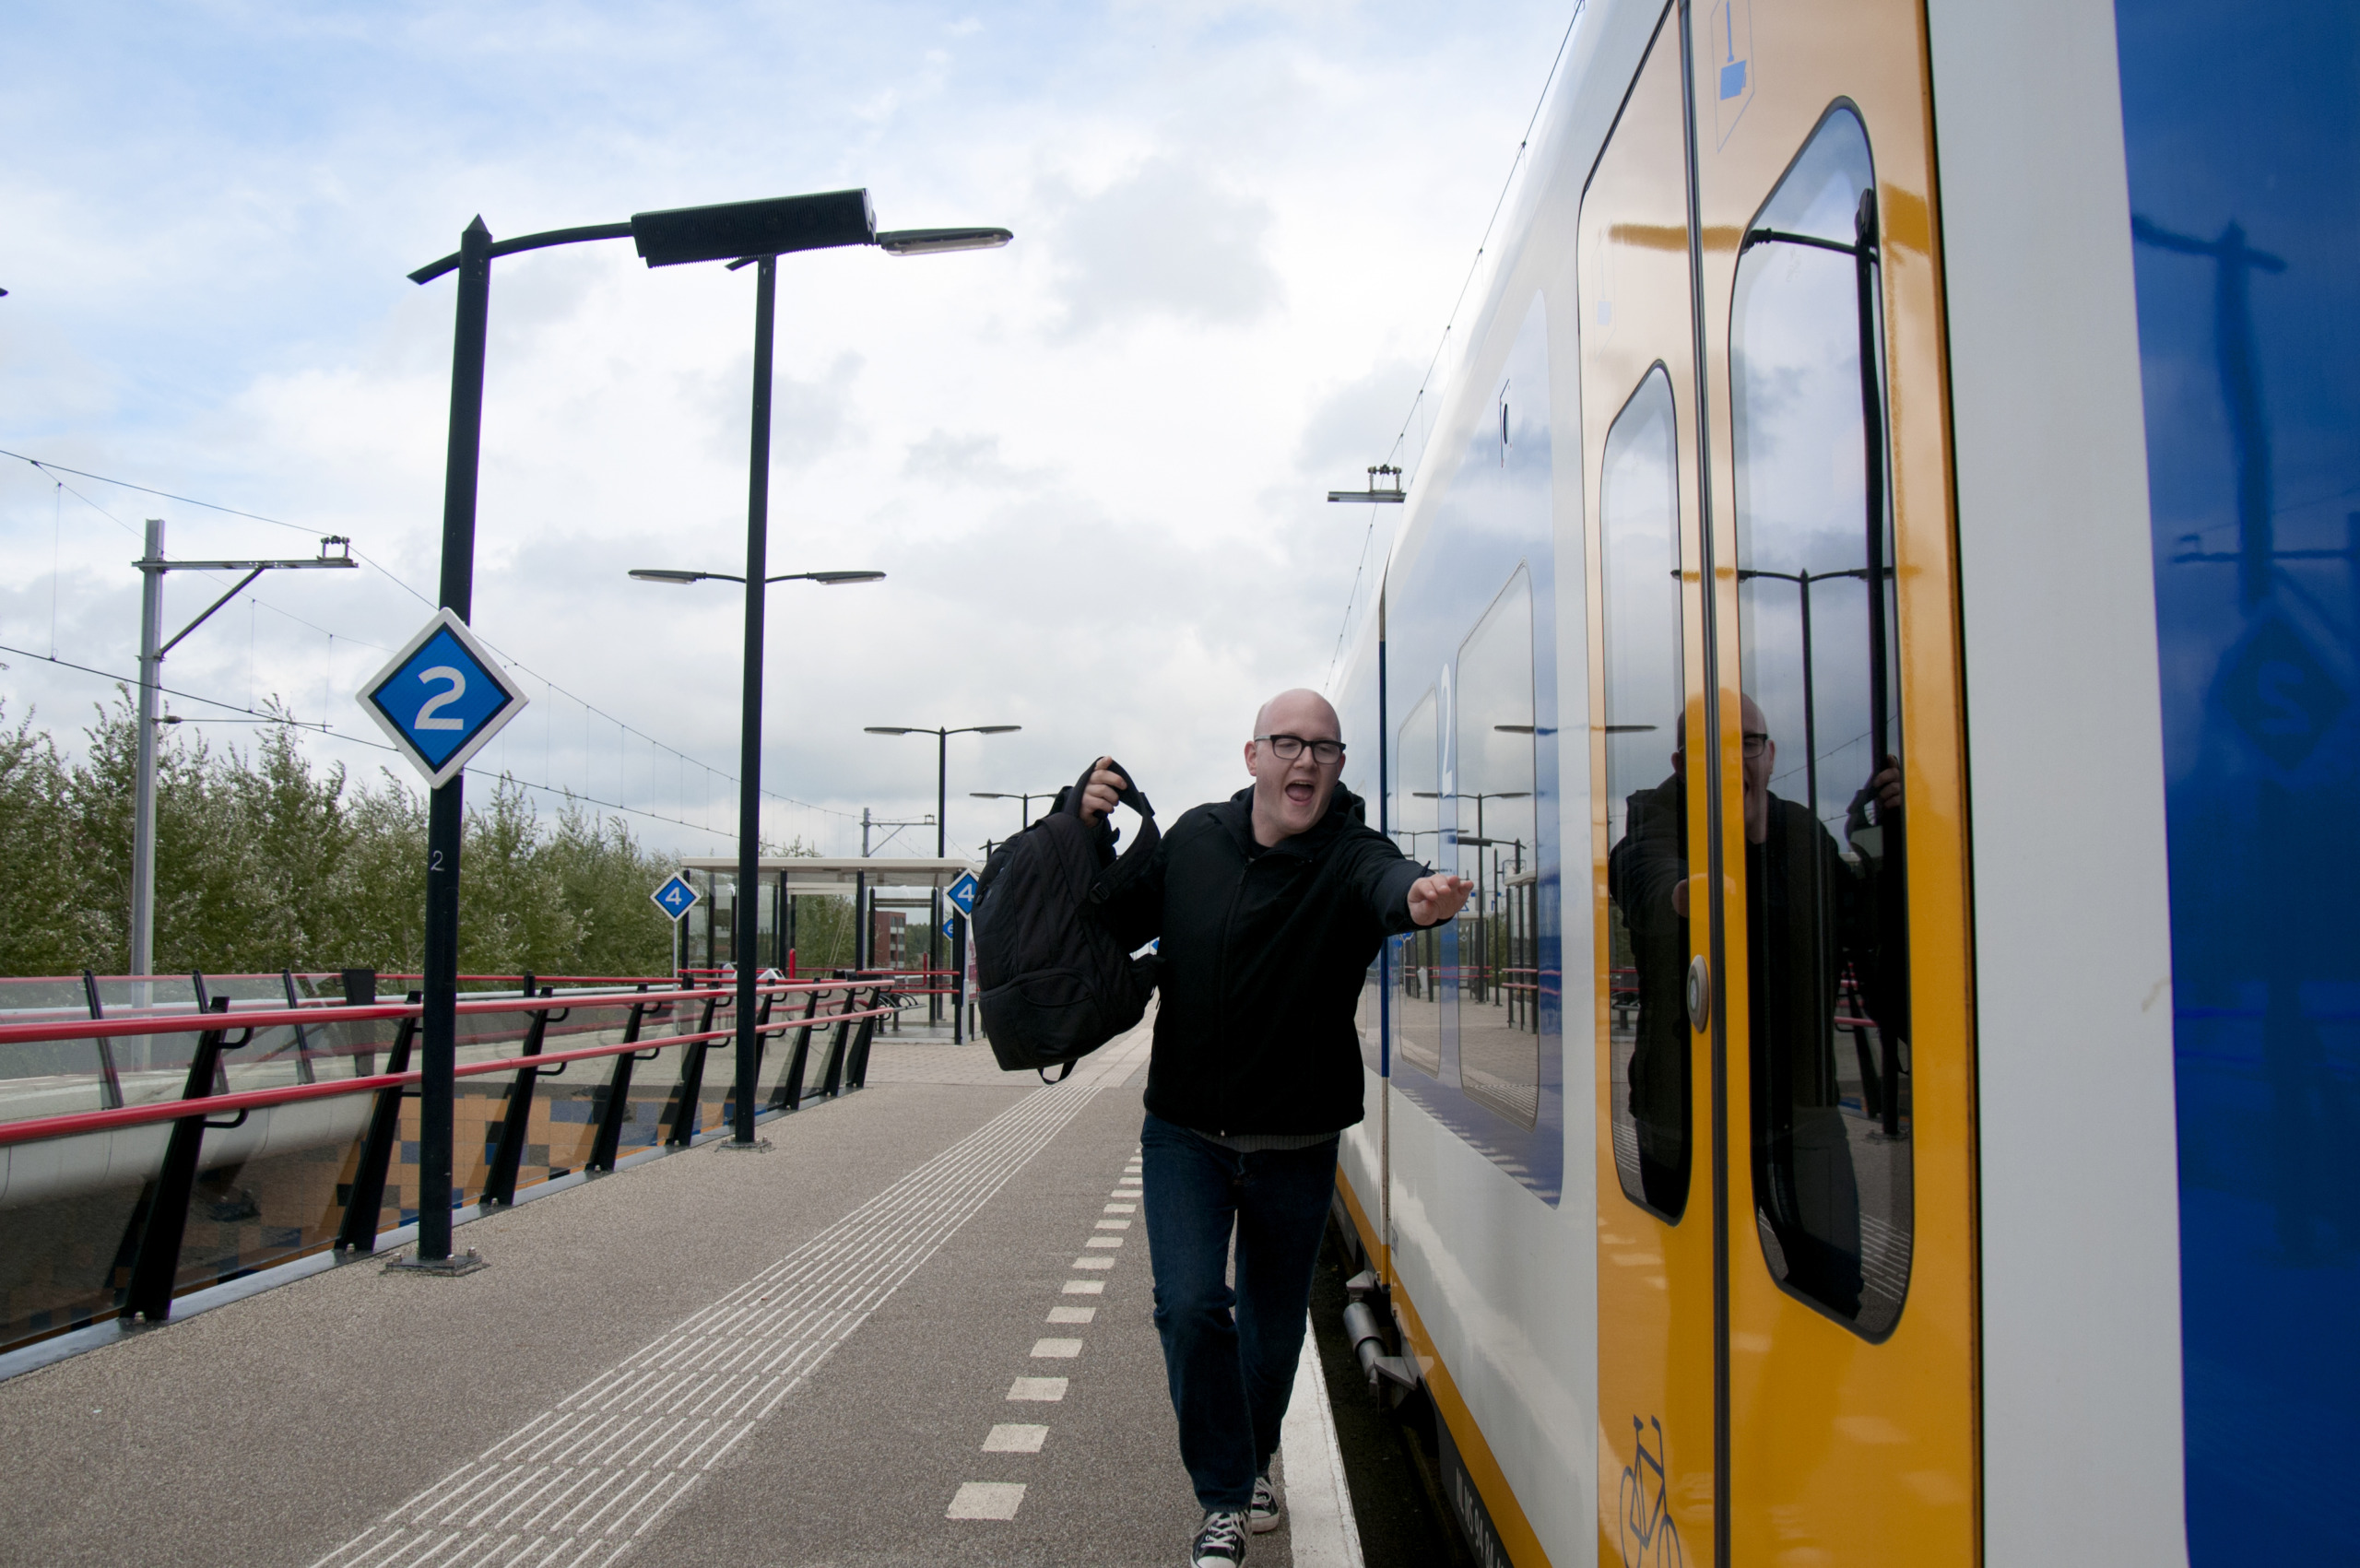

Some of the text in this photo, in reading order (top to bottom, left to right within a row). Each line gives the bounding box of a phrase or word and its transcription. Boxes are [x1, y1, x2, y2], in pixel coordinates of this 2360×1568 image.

[413, 666, 466, 730] 2
[1441, 663, 1453, 798] 2
[431, 850, 445, 871] 2
[665, 887, 682, 905] 4
[957, 883, 974, 902] 4
[1457, 1467, 1464, 1515] NL
[1464, 1485, 1473, 1535] NS
[1475, 1508, 1484, 1559] 94
